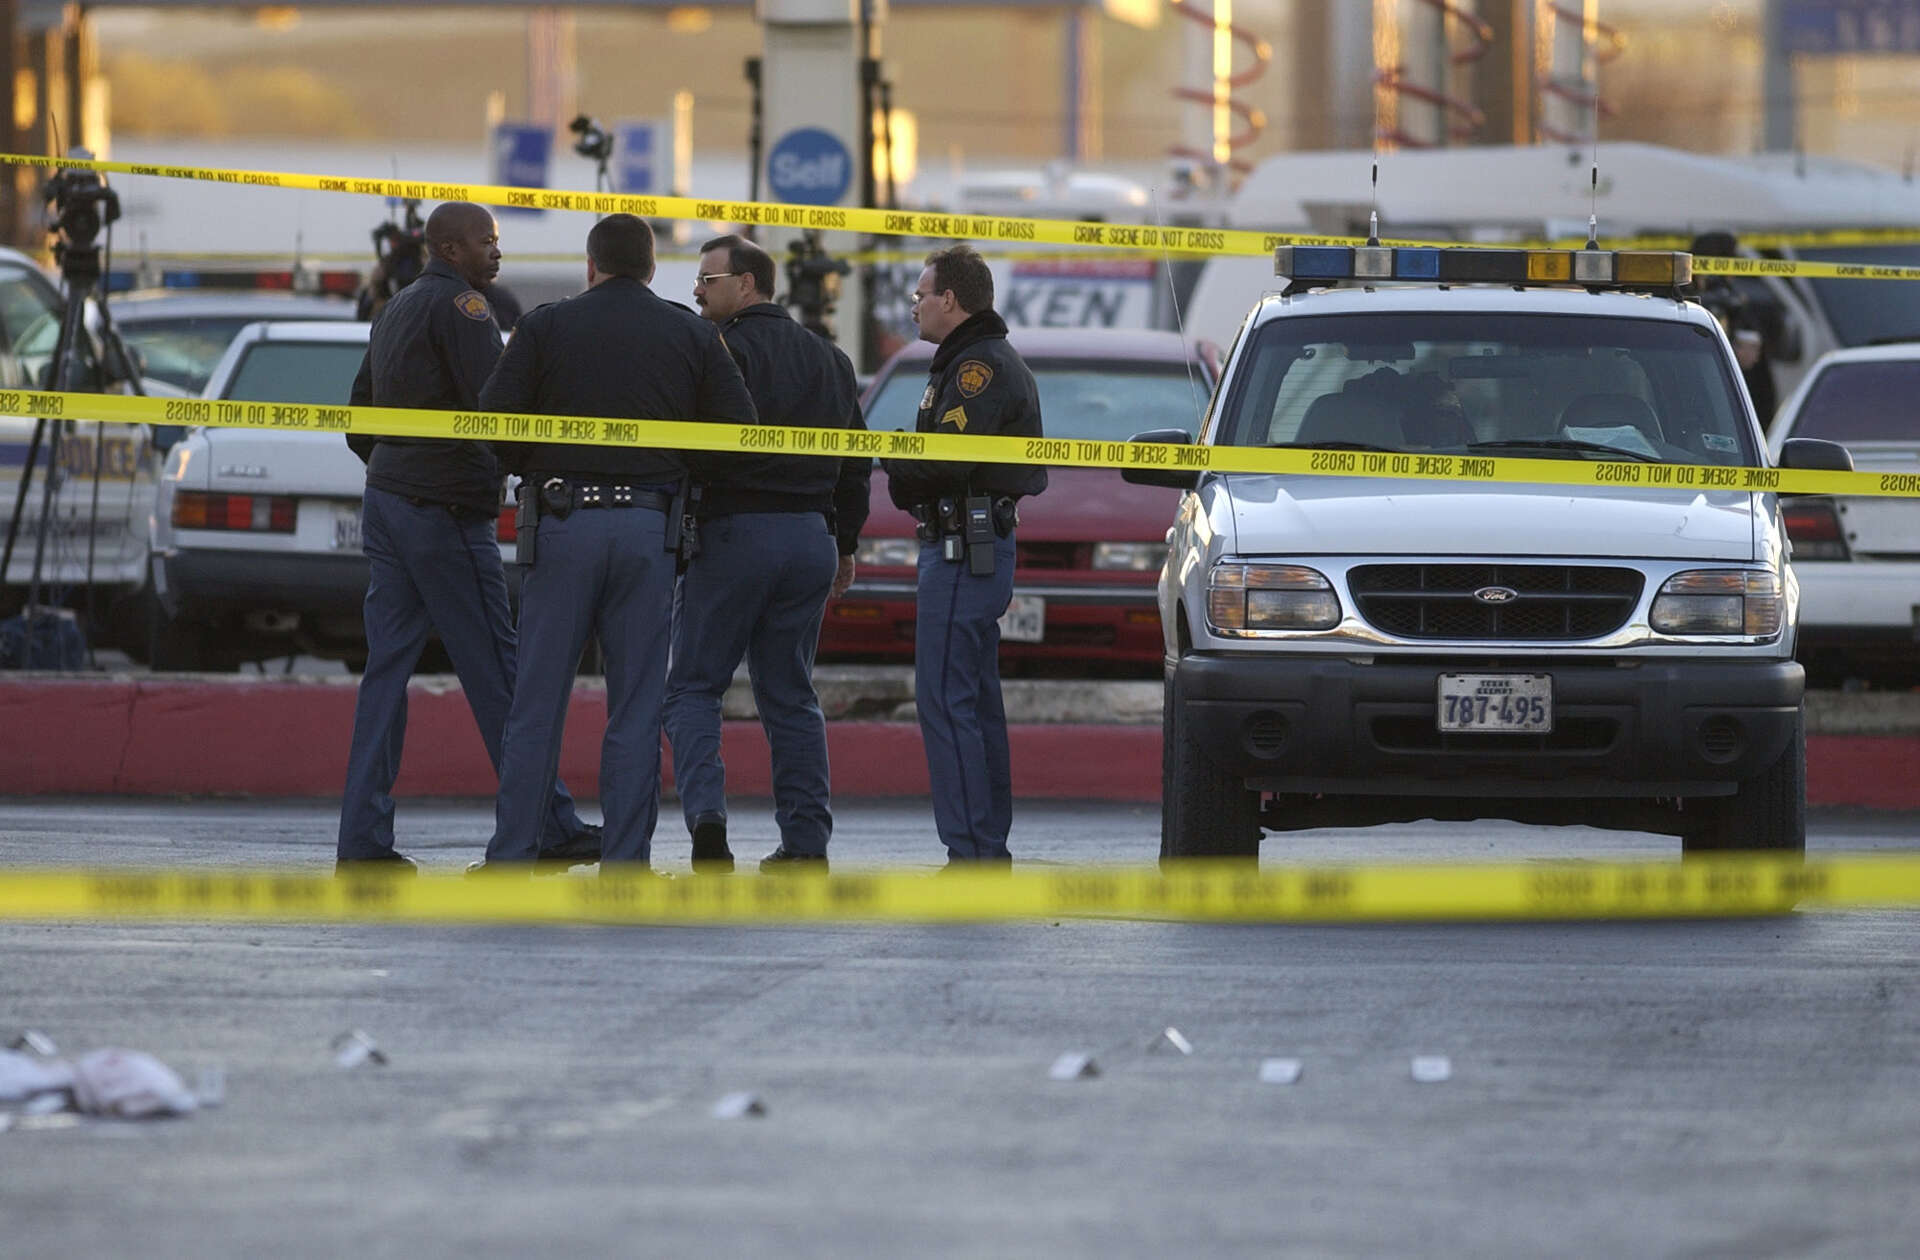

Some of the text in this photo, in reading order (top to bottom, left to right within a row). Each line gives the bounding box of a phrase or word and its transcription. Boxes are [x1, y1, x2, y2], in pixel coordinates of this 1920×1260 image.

[130, 165, 281, 187] CRIME SCENE DO NOT CROSS
[775, 152, 844, 188] Self
[319, 178, 469, 202] CRIME SCENE DO NOT CROSS
[507, 192, 657, 215] CRIME SCENE DO NOT CROSS
[696, 203, 846, 227] CRIME SCENE DO NOT CROSS
[885, 214, 1035, 240] CRIME SCENE DO NOT CROSS
[1074, 226, 1225, 250] CRIME SCENE DO NOT CROSS
[1445, 694, 1545, 724] 787-495
